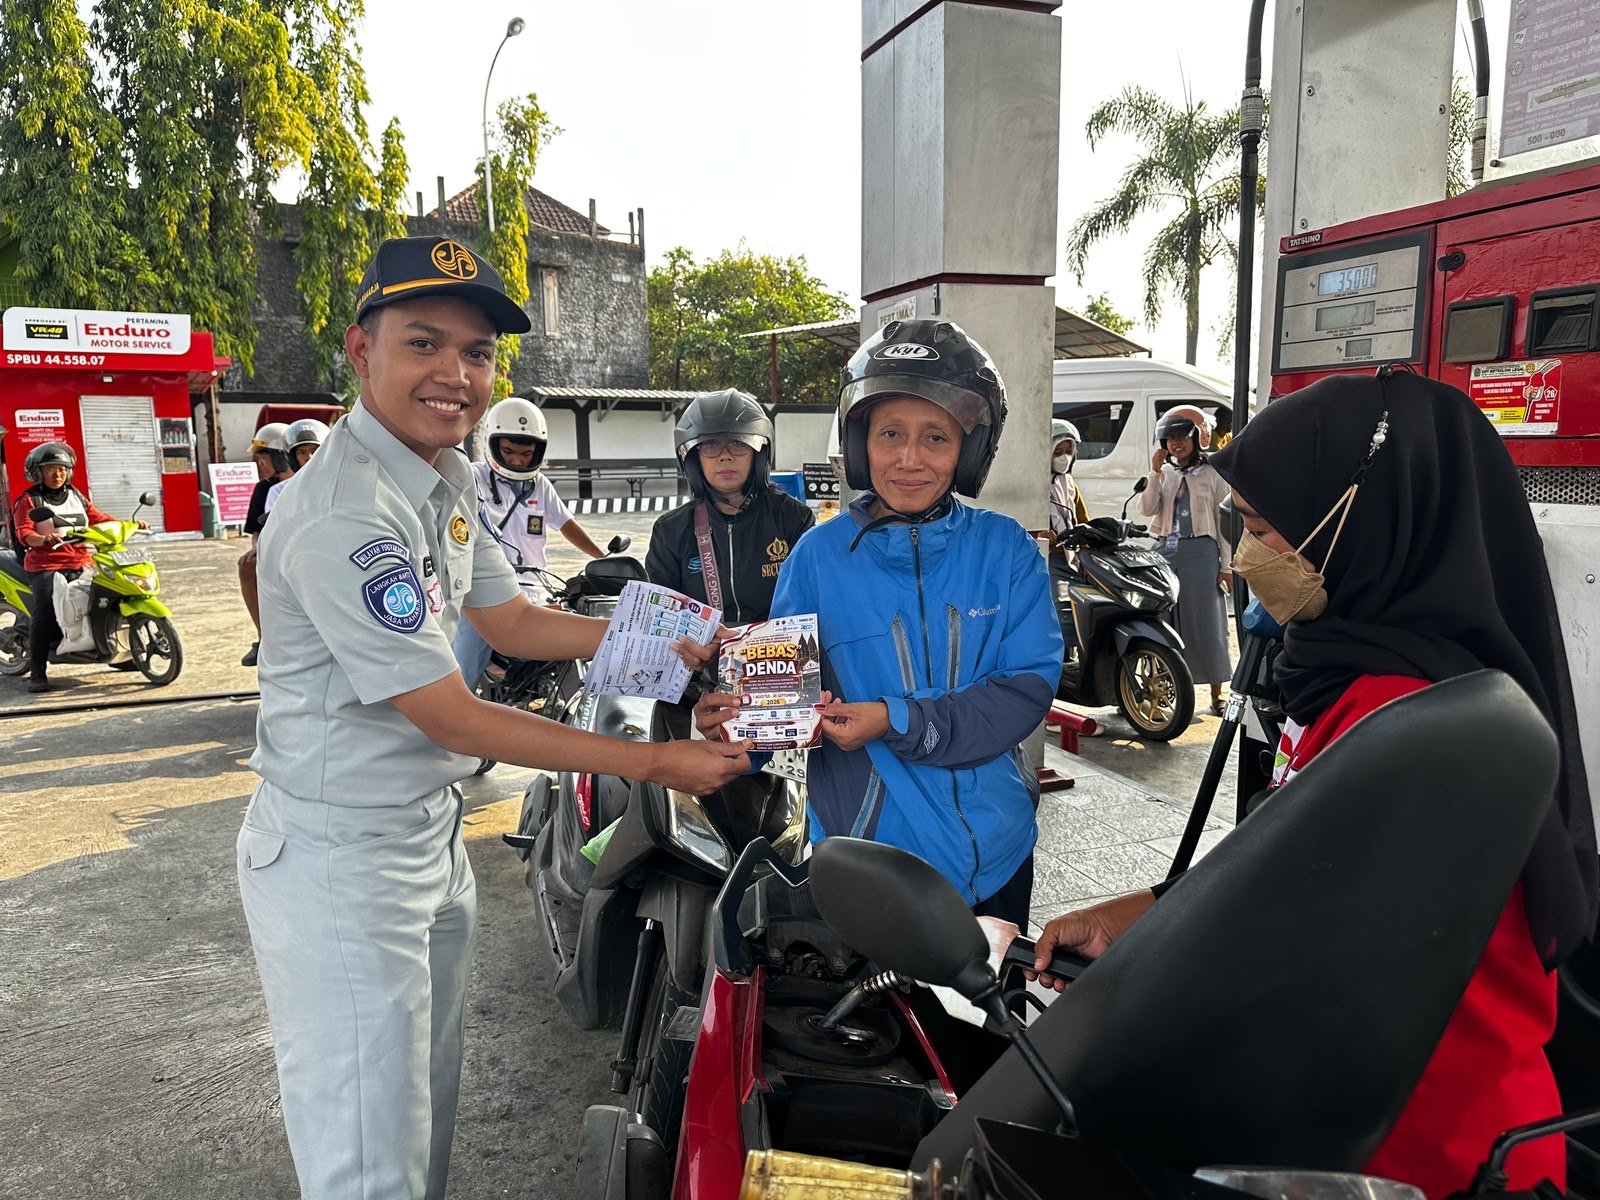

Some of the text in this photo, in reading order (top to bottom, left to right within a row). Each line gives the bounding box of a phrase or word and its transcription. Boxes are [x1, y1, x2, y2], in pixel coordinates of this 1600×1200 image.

[1290, 234, 1321, 247] TATSUNO
[126, 317, 169, 325] PERTAMINA
[84, 323, 170, 338] Enduro
[91, 339, 172, 349] MOTOR SERVICE
[7, 354, 105, 366] SPBU 44.558.07
[215, 469, 252, 477] Enduro
[358, 545, 380, 563] WILAYAH
[704, 552, 717, 580] XUAN
[369, 576, 398, 594] LANGKAH
[384, 599, 421, 625] JASA RAHARJA
[746, 660, 796, 676] DENDA
